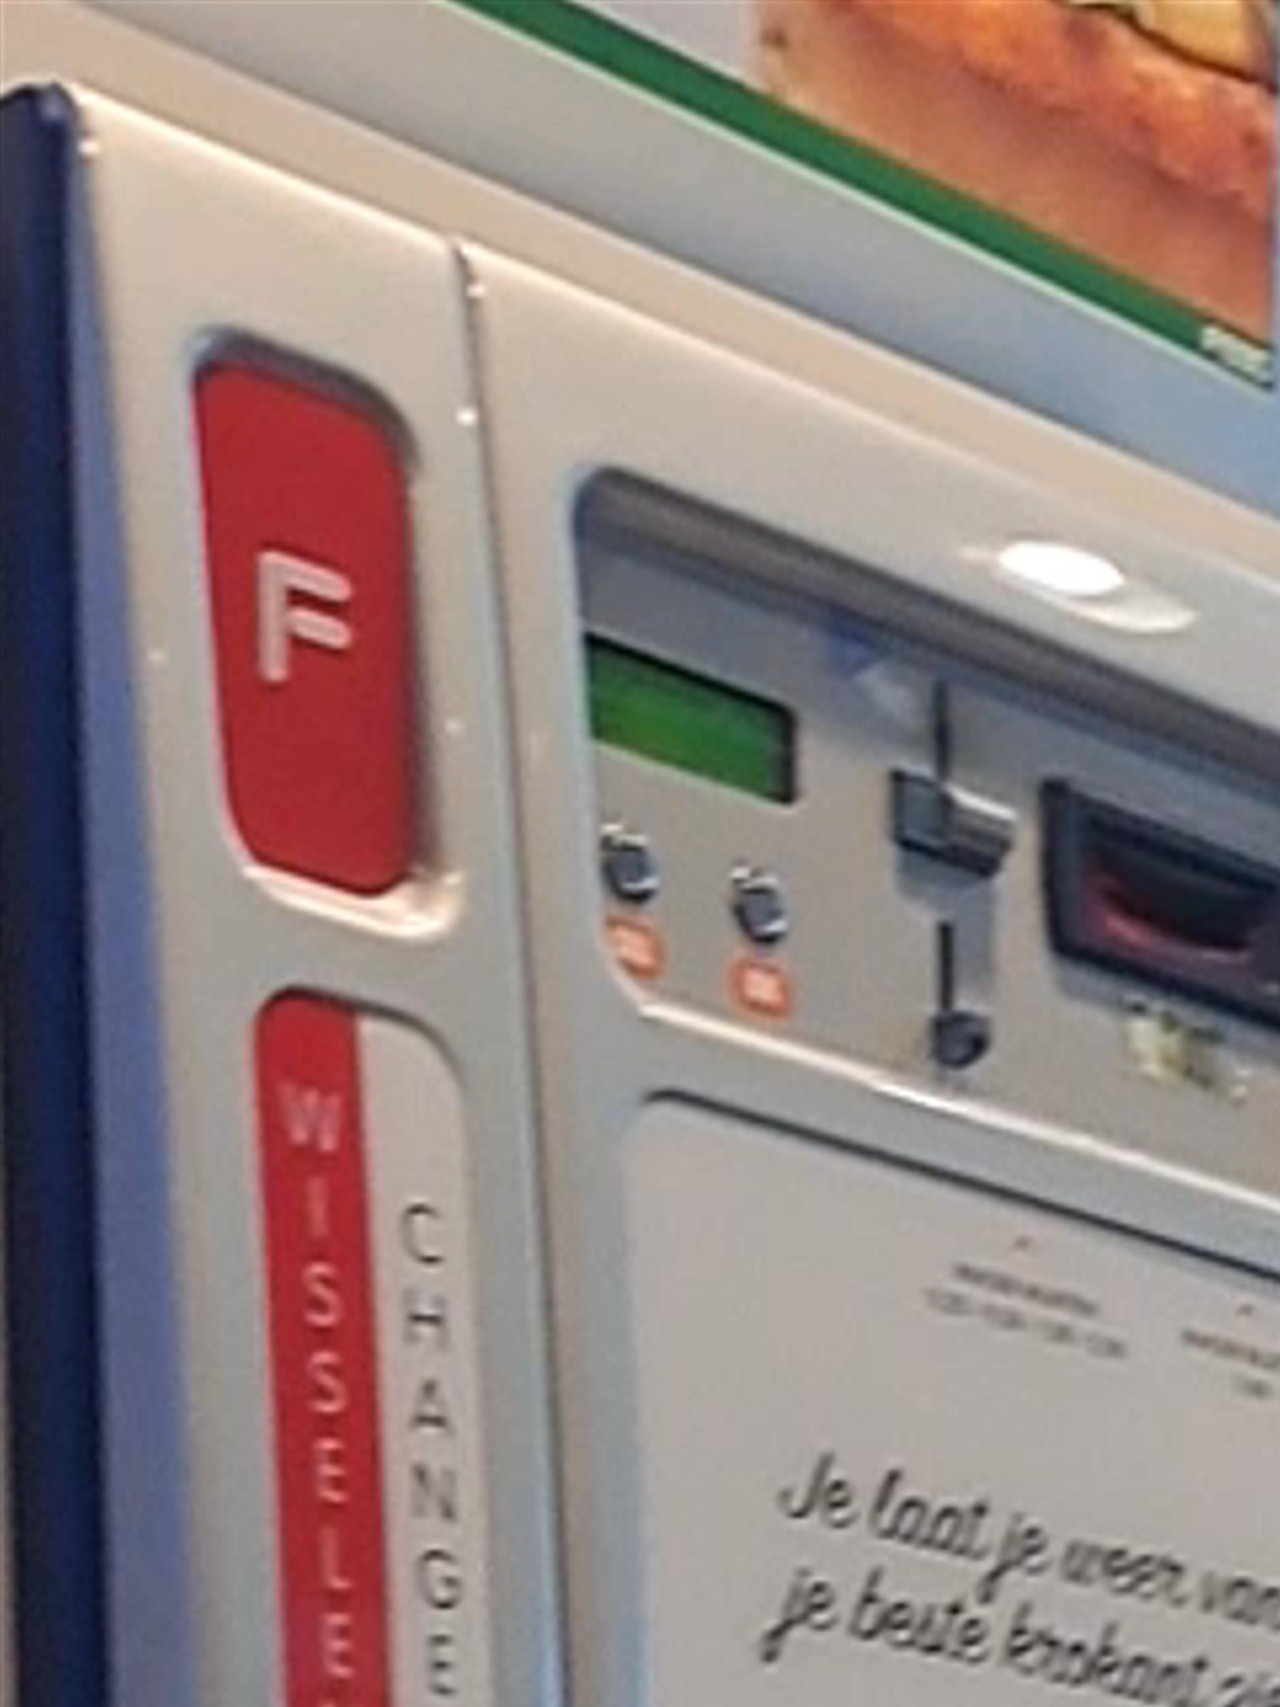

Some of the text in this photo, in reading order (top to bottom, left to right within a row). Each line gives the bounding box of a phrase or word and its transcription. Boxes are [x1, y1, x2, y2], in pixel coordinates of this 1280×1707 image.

[256, 548, 353, 684] F
[401, 1202, 465, 1700] CHANGE
[777, 1451, 858, 1529] Je
[868, 1468, 990, 1561] laat
[973, 1510, 1050, 1605] je
[1060, 1538, 1188, 1609] weer
[758, 1566, 838, 1664] je
[847, 1565, 990, 1667] beste
